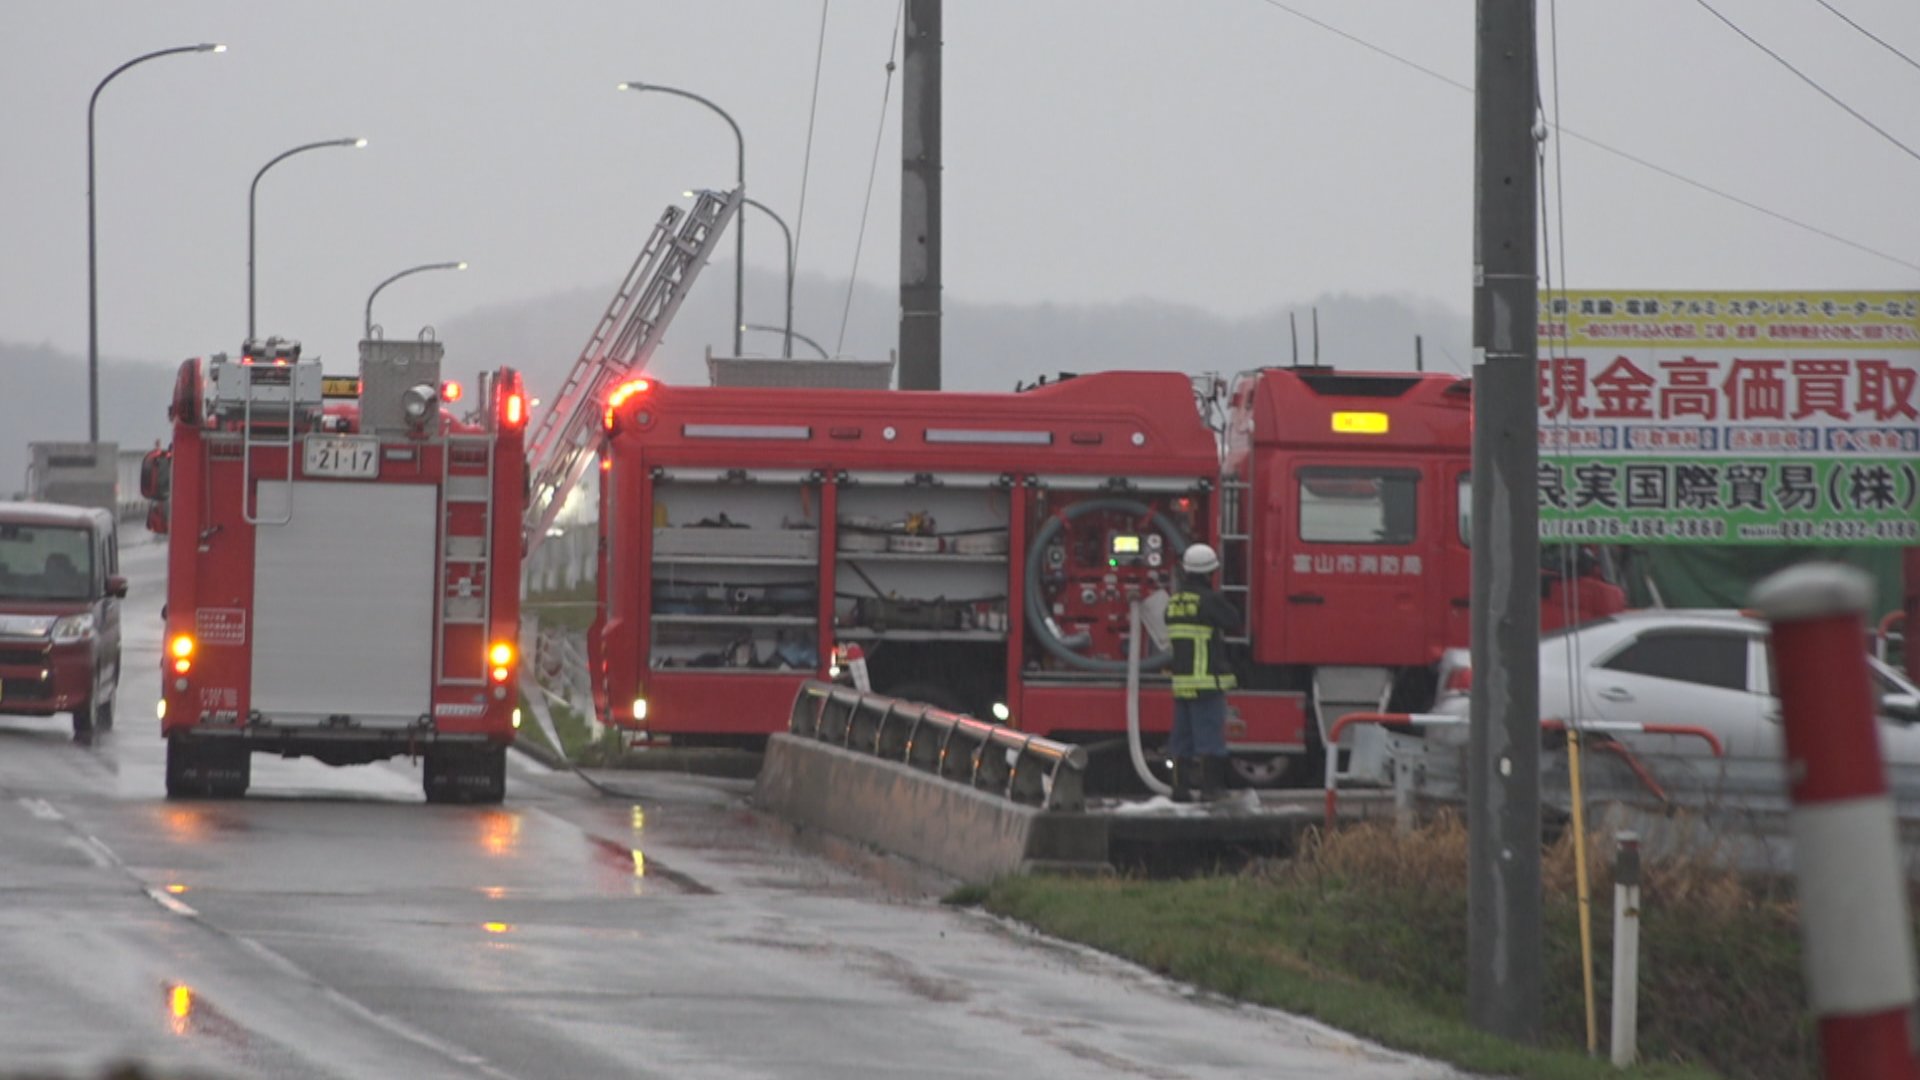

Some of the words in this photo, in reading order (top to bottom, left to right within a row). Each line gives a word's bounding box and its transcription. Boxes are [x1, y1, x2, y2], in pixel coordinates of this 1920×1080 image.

[1537, 355, 1919, 420] 現金高価買取
[1292, 553, 1423, 576] 富山市消防局
